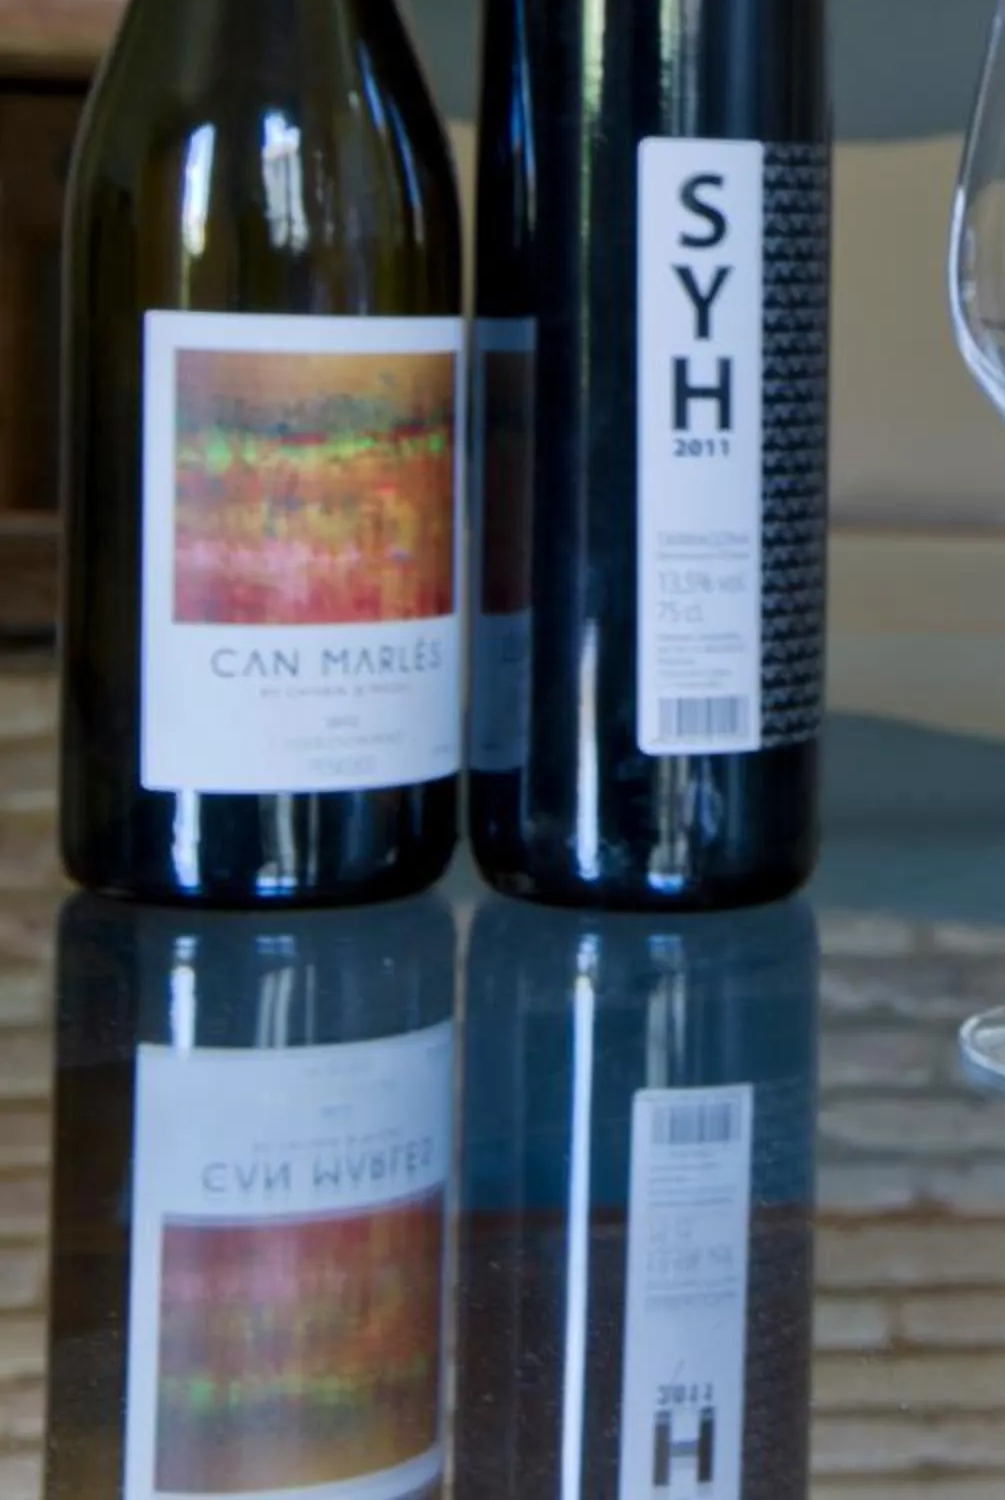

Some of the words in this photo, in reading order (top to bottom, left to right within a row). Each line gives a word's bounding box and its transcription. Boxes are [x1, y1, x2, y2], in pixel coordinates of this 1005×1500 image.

[671, 172, 733, 432] SYH
[673, 438, 731, 458] 2011
[210, 648, 299, 678] CAN
